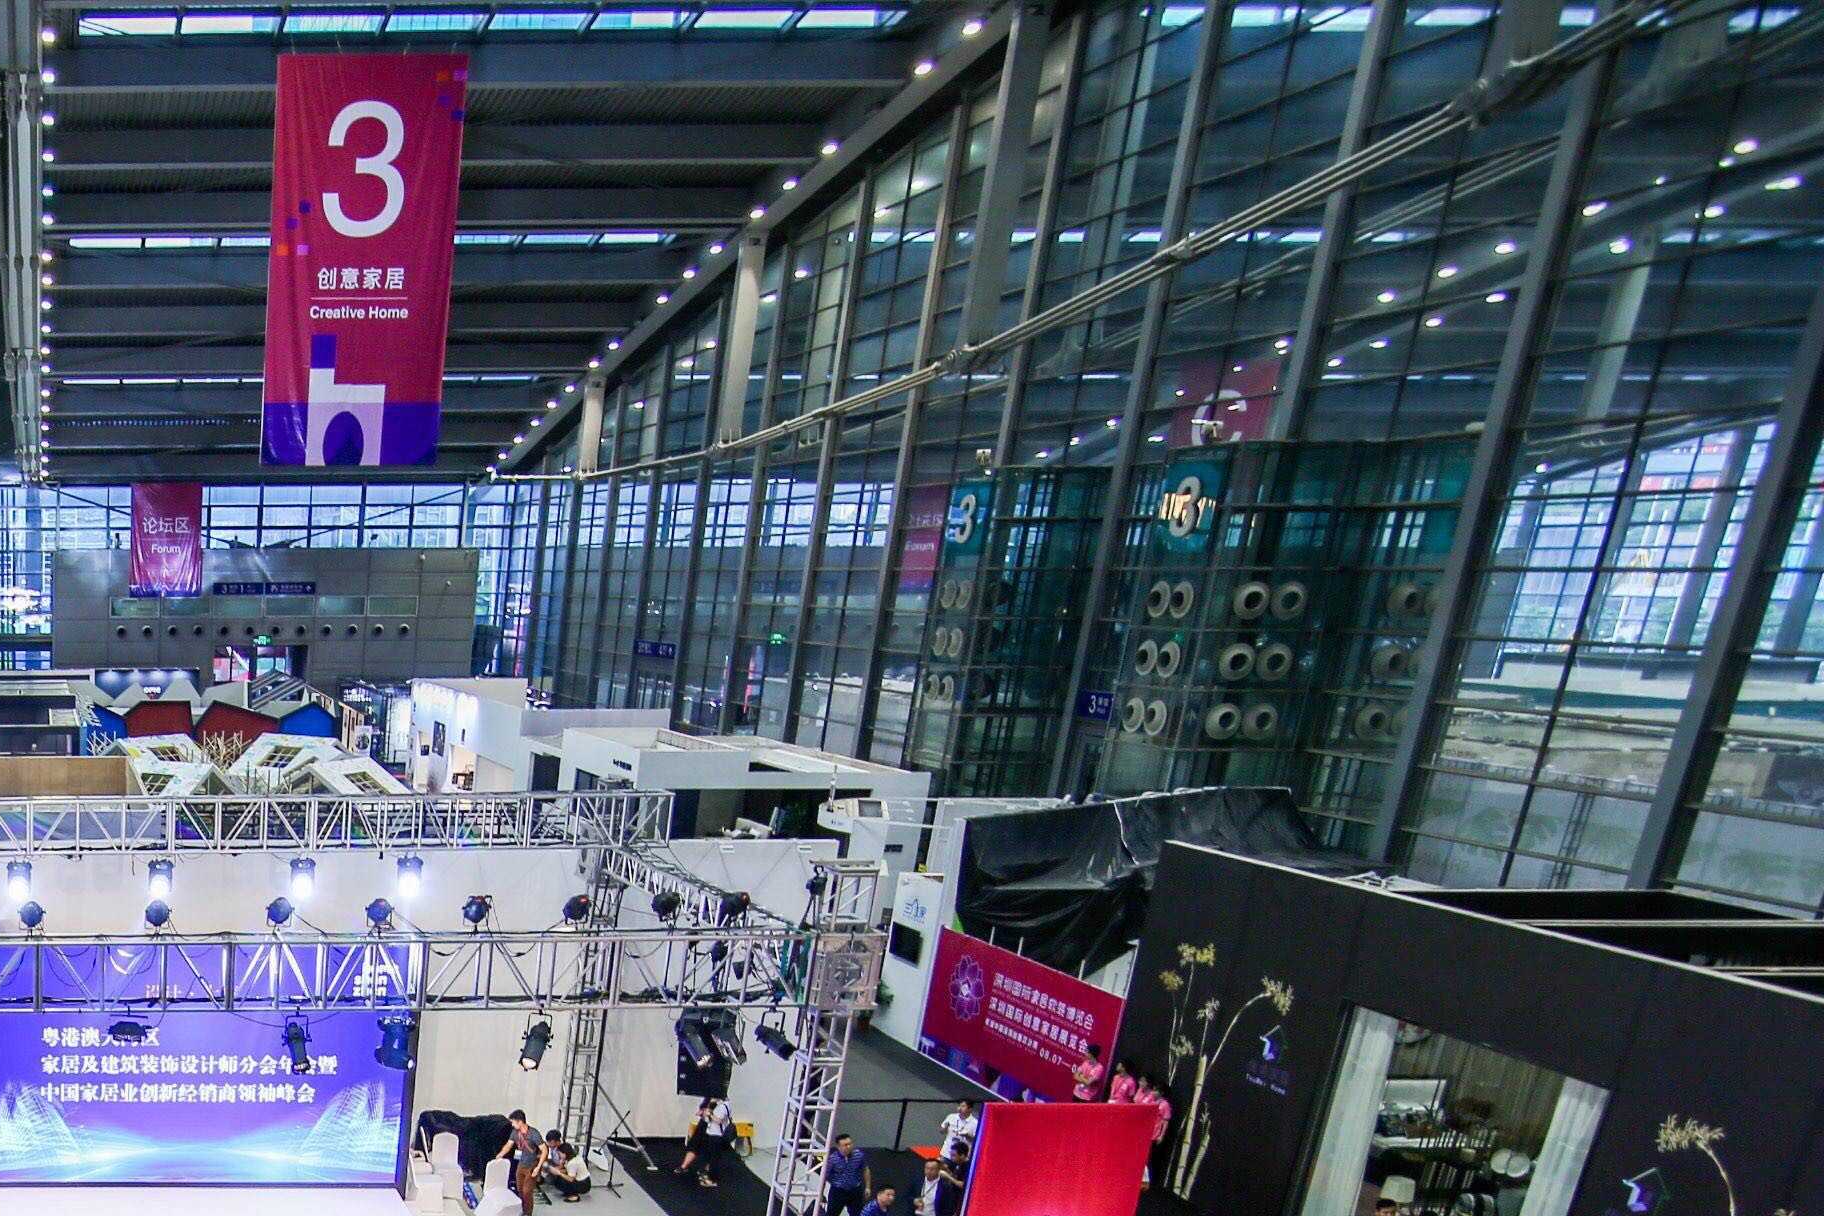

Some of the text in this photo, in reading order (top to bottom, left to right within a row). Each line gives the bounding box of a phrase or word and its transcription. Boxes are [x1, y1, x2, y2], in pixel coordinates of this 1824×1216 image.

[322, 100, 405, 237] 3
[317, 267, 405, 289] 创意家居
[309, 306, 409, 319] Creative Home
[1169, 476, 1202, 537] 3
[143, 517, 190, 534] 论坛区
[956, 494, 976, 543] 3
[151, 544, 182, 554] Forum
[1088, 694, 1096, 714] 3
[41, 1027, 160, 1047] 粤港澳大区
[40, 1083, 317, 1104] 中国家居业创新经销商领袖峰会
